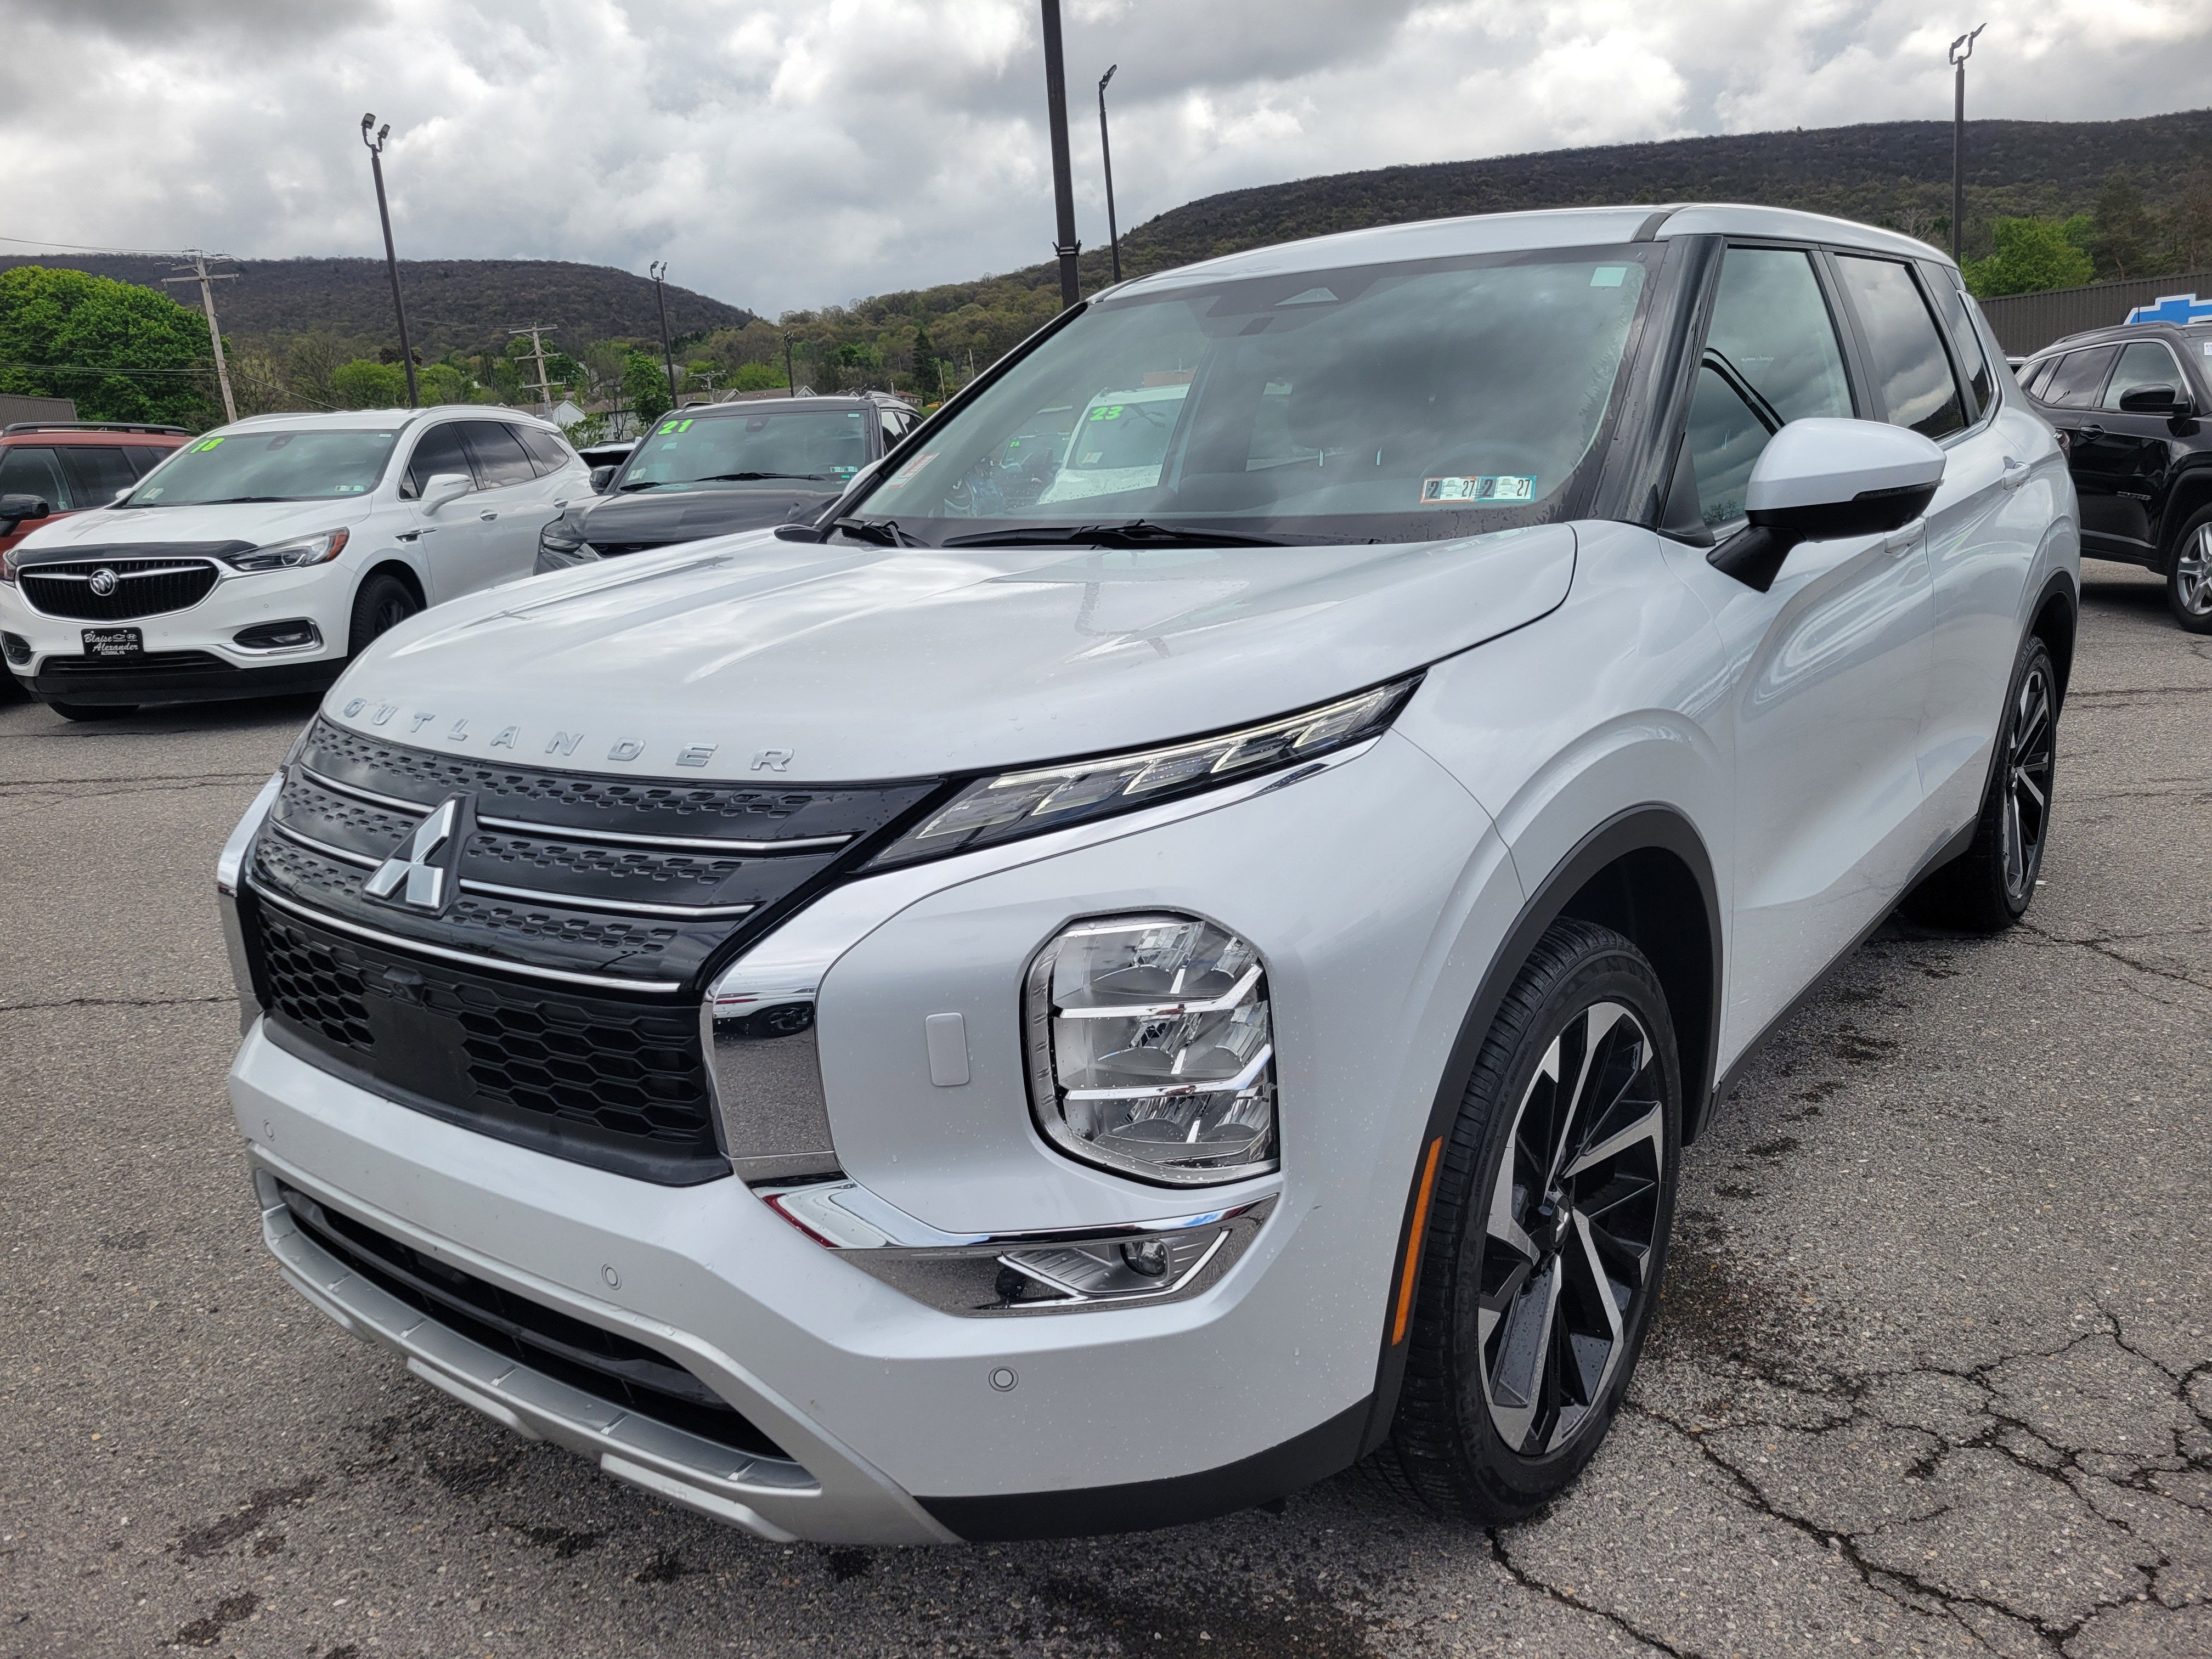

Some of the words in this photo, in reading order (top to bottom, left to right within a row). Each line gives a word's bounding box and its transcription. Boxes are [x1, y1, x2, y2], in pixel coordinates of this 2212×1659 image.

[1089, 405, 1124, 421] 23
[658, 419, 694, 435] 21
[190, 438, 225, 454] 18
[1429, 481, 1440, 499] 2
[1461, 480, 1475, 499] 27
[1482, 478, 1493, 497] 2
[1516, 478, 1531, 498] 27
[84, 633, 112, 643] Blaise
[92, 642, 139, 652] Alexander
[343, 697, 794, 772] OUTLANDER
